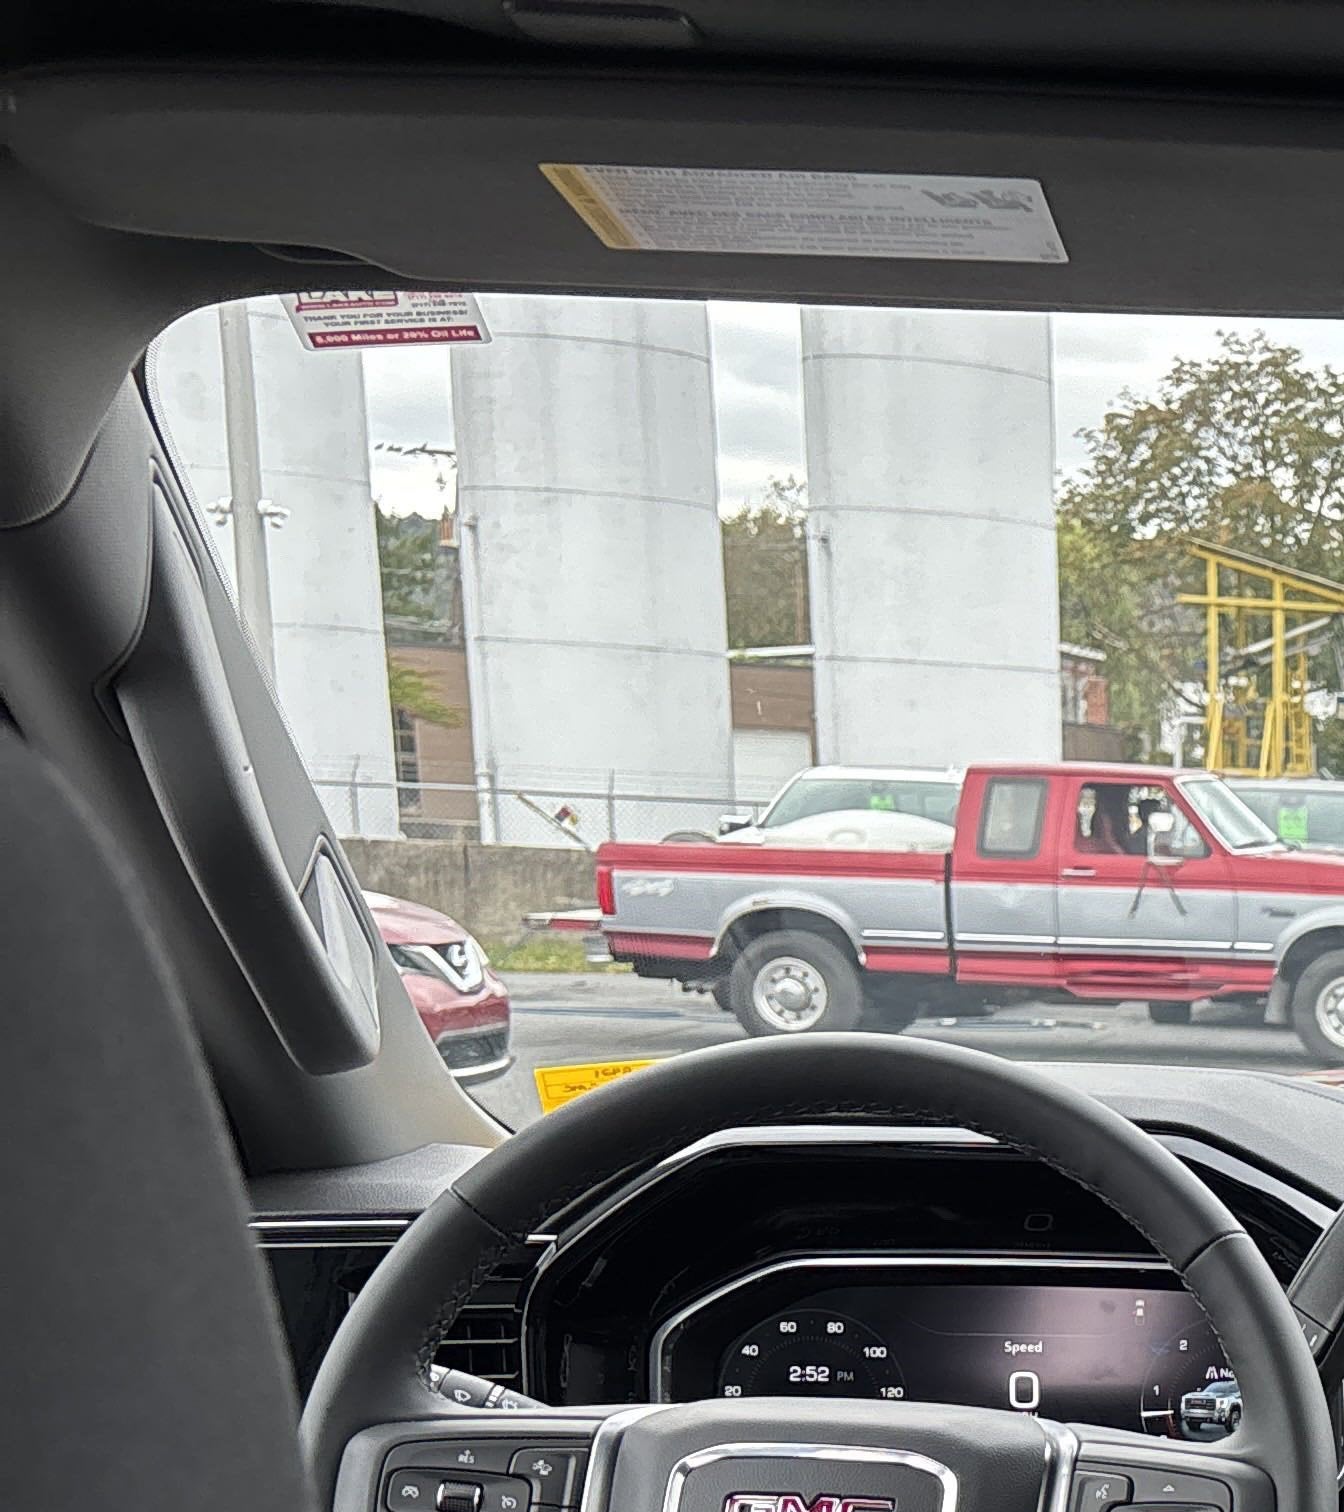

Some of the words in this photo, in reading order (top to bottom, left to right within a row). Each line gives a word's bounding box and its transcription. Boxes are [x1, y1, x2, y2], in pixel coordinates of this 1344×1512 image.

[351, 333, 384, 341] Miles
[386, 332, 400, 340] or
[430, 329, 449, 338] Oil
[451, 328, 475, 337] Life
[779, 1321, 797, 1333] 60
[826, 1321, 844, 1334] 80
[741, 1344, 759, 1357] 40
[1004, 1340, 1043, 1356] Speed
[1179, 1339, 1188, 1351] 2
[863, 1346, 887, 1358] 100
[789, 1366, 830, 1382] 2:52
[836, 1371, 855, 1382] PM
[724, 1385, 742, 1397] 20
[880, 1386, 905, 1398] 120
[1009, 1371, 1040, 1410] 0
[1153, 1385, 1160, 1396] 1
[458, 1454, 475, 1464] RES
